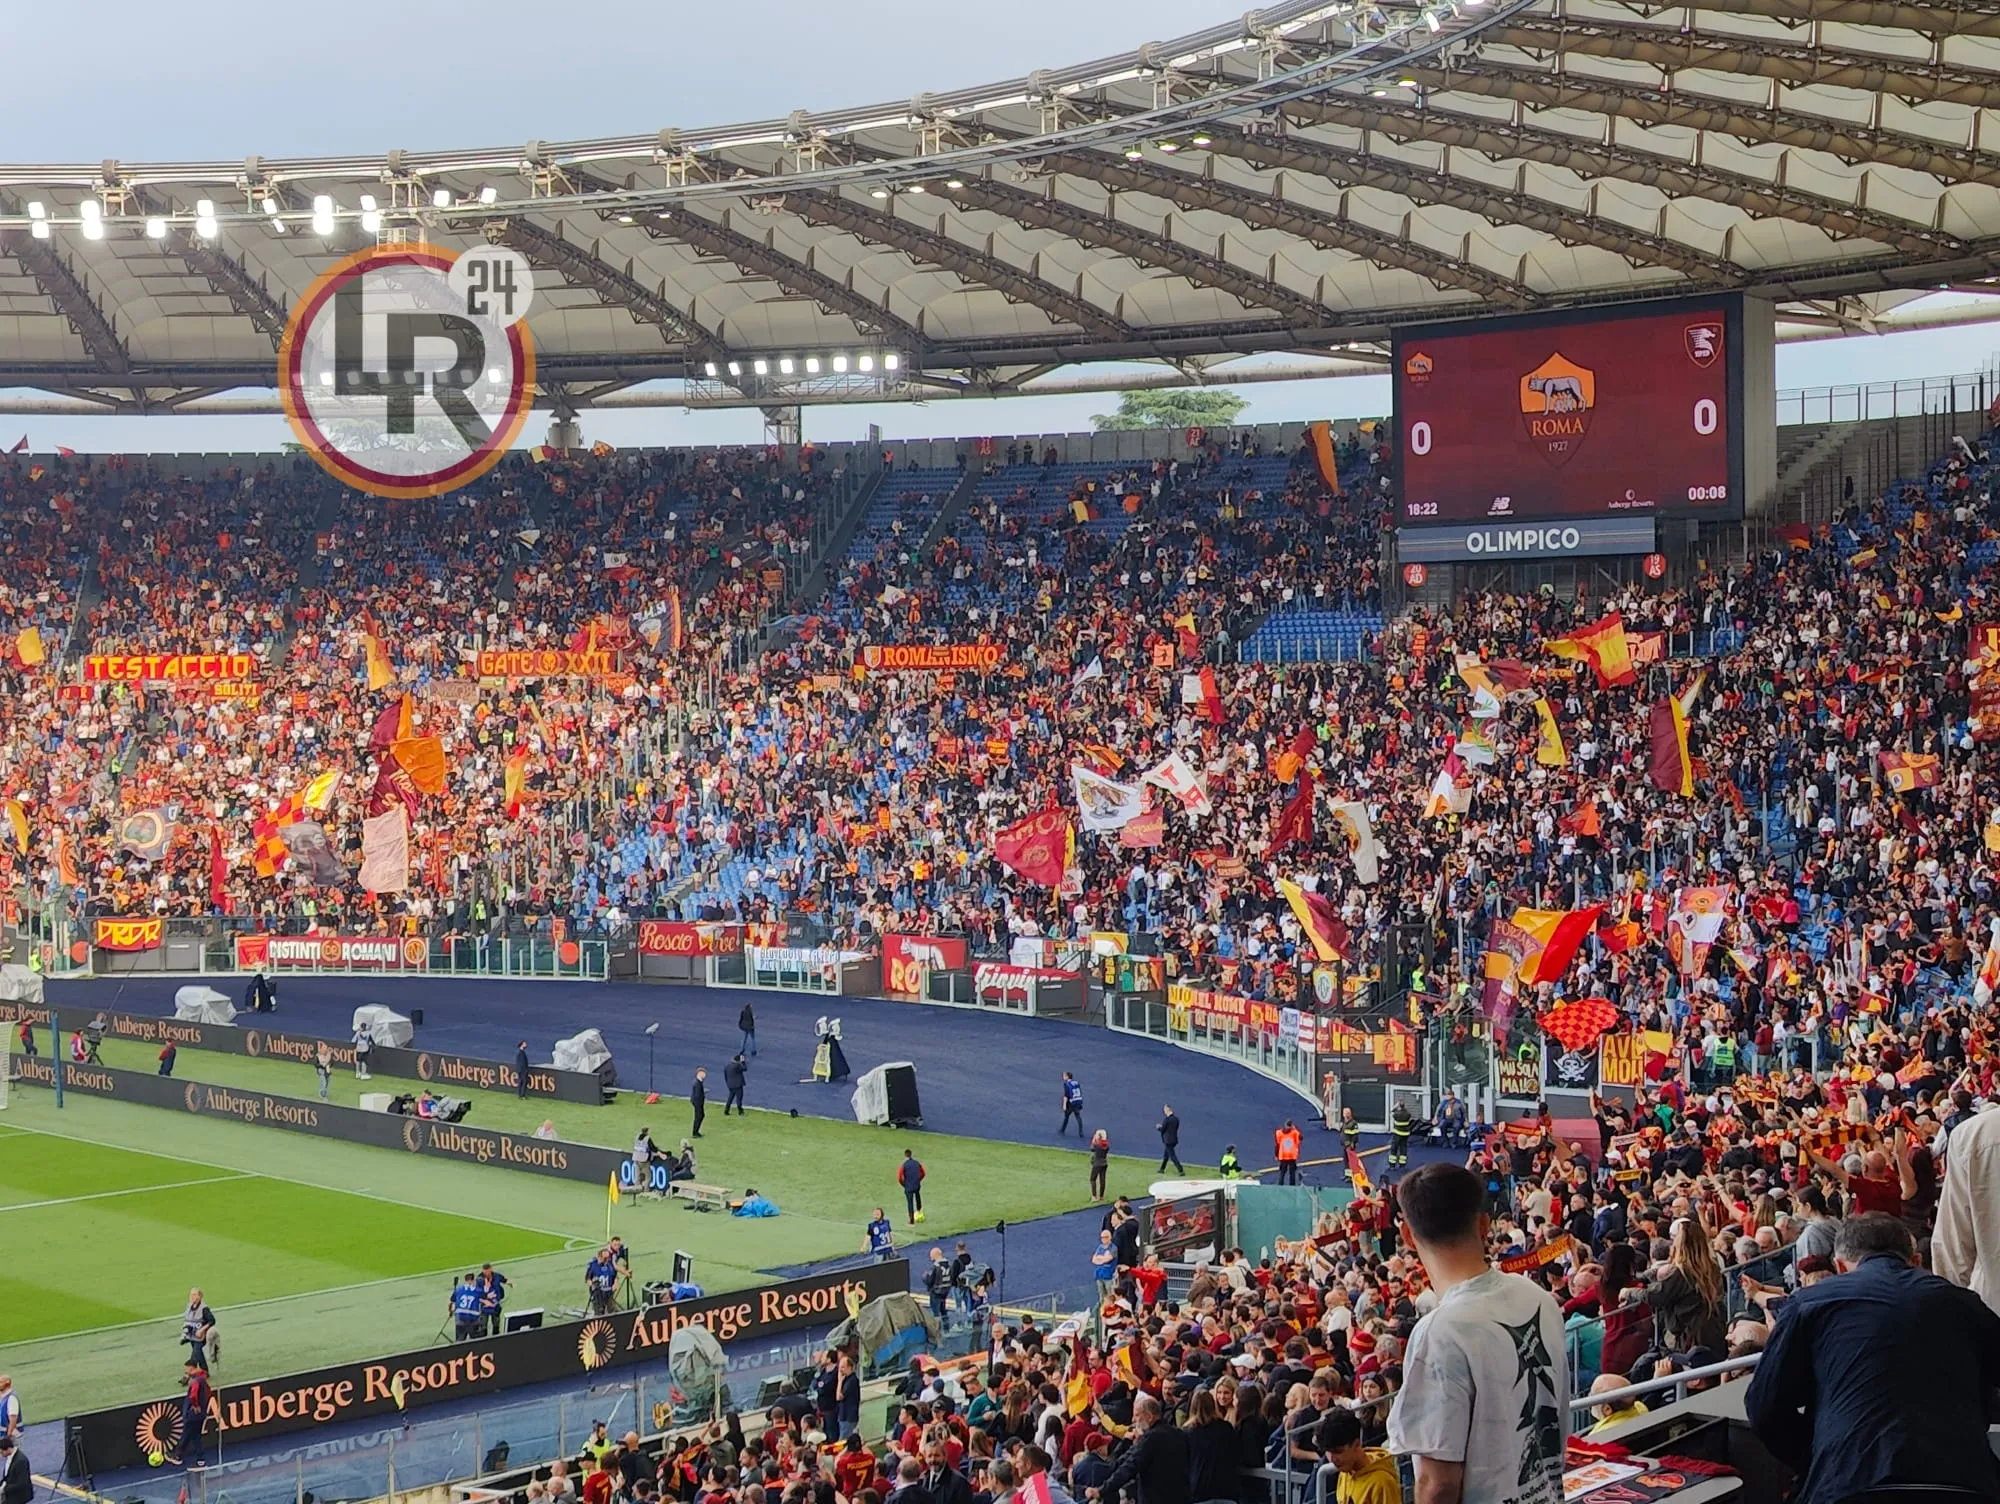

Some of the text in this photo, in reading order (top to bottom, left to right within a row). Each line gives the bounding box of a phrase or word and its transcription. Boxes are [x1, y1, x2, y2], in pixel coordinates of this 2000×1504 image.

[1531, 417, 1585, 437] ROMA
[1694, 398, 1717, 435] 0
[1411, 421, 1431, 455] 0
[1688, 486, 1727, 501] 00:08
[1466, 527, 1580, 553] OLIMPICO
[89, 656, 250, 679] TESTACCIO
[481, 654, 534, 674] GATE
[341, 943, 396, 962] ROMANI
[111, 1016, 202, 1043] Auberge Resorts
[265, 1034, 314, 1062] Auberge
[66, 1065, 114, 1091] Resorts
[437, 1058, 556, 1092] Auberge Reorts
[205, 1087, 318, 1127] Auberge Resorts
[428, 1125, 567, 1170] Auberge Resorts
[459, 1295, 474, 1308] 37
[626, 1278, 868, 1350] Auberge Resorts
[201, 1350, 496, 1435] Auberge Resorts
[856, 1469, 868, 1489] 7
